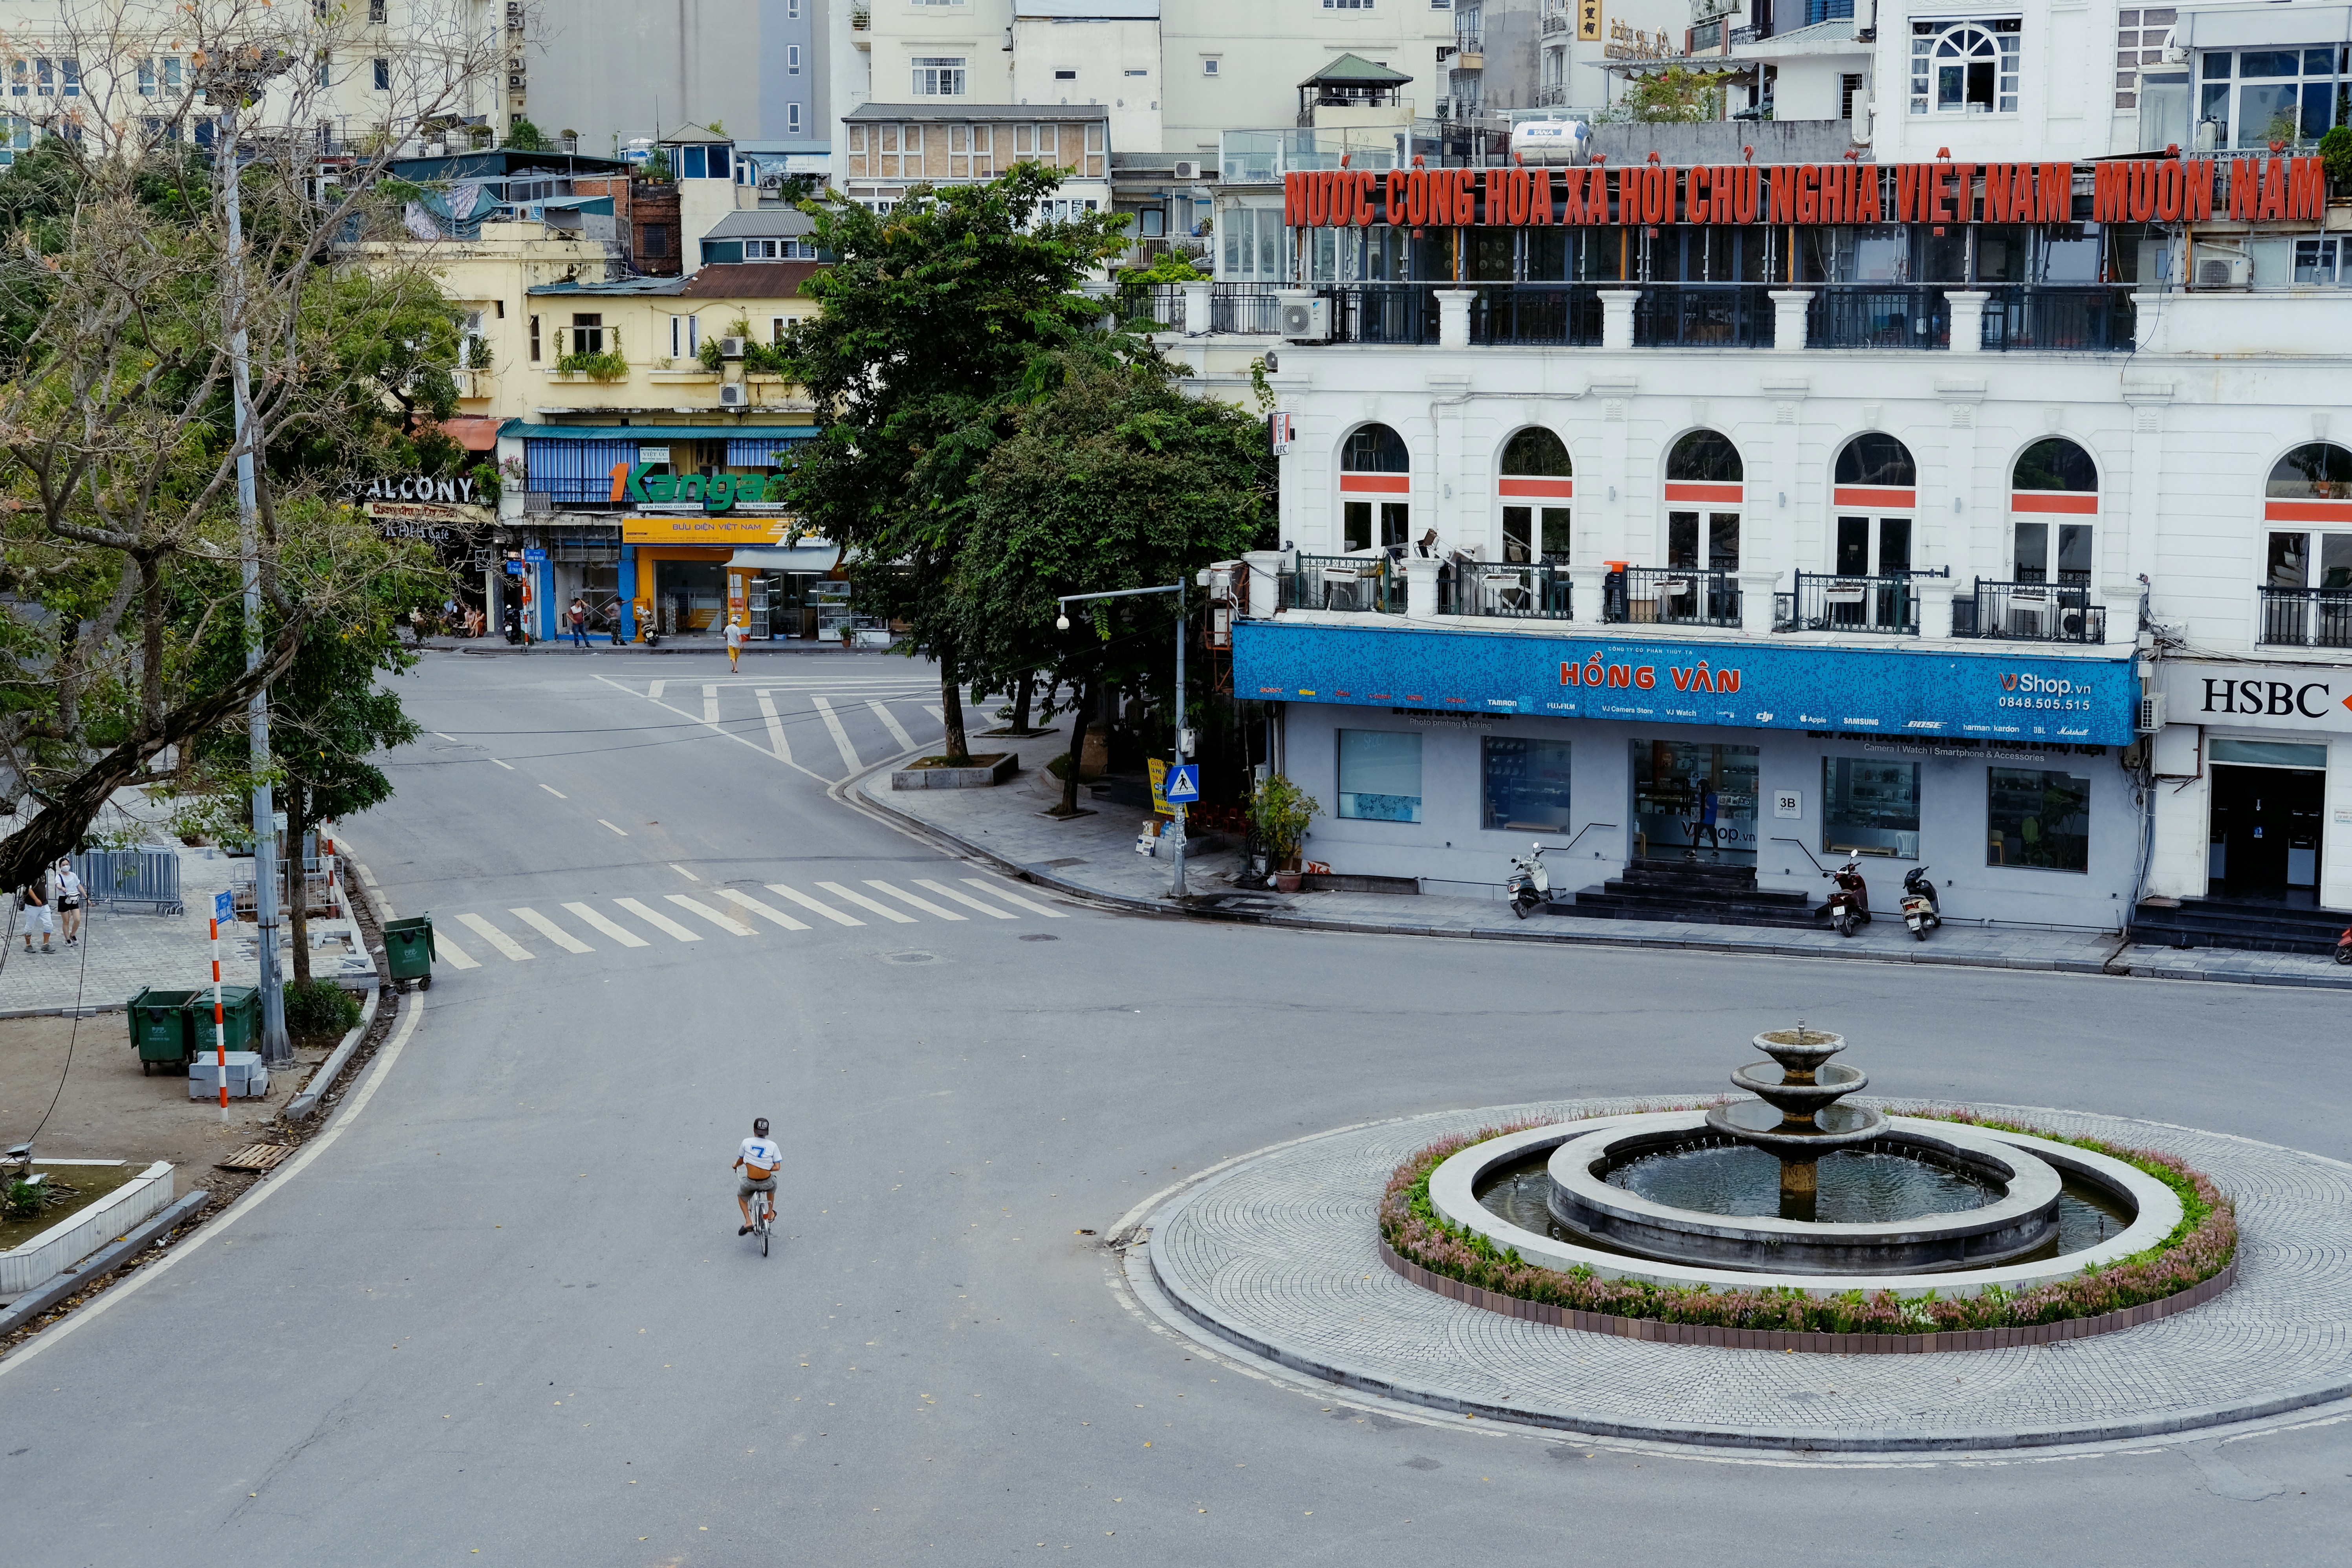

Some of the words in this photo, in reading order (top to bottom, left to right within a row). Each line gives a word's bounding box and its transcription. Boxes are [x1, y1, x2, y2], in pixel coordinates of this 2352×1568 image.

[1285, 154, 1376, 226] NƯỚC
[1386, 154, 1475, 238] CỘNG
[1486, 151, 1553, 225] HÒA
[1563, 152, 1610, 224] XÃ
[1619, 150, 1676, 238] HỘI
[1687, 145, 1759, 225] CHỦ
[1770, 149, 1881, 223] NGHĨA
[1896, 147, 1977, 236] VIỆT
[1984, 162, 2072, 223] NAM
[2093, 143, 2215, 222] MUÔN
[2229, 141, 2325, 220] NĂM
[1276, 445, 1287, 454] KFC
[694, 522, 715, 531] ĐIỆN
[718, 522, 738, 531] VIỆT
[1560, 650, 1655, 690] HỒNG
[1670, 660, 1741, 693] VÂN
[1999, 696, 2090, 711] 0848.505.515
[2200, 678, 2329, 718] HSBC
[1409, 718, 1431, 726] Photo
[1433, 719, 1460, 728] printing
[1469, 721, 1492, 730] taking
[1808, 716, 1827, 724] Apple
[1844, 717, 1879, 725] SAMSUNG
[1907, 720, 1944, 729] BOSE
[2057, 726, 2089, 736] Marshall
[1864, 743, 1894, 752] Camera
[1902, 745, 1927, 754] Watch
[1934, 747, 1984, 758] Smartphone
[1994, 751, 2045, 762] Accessories
[1780, 798, 1795, 808] 3B
[751, 1145, 766, 1158] 7
